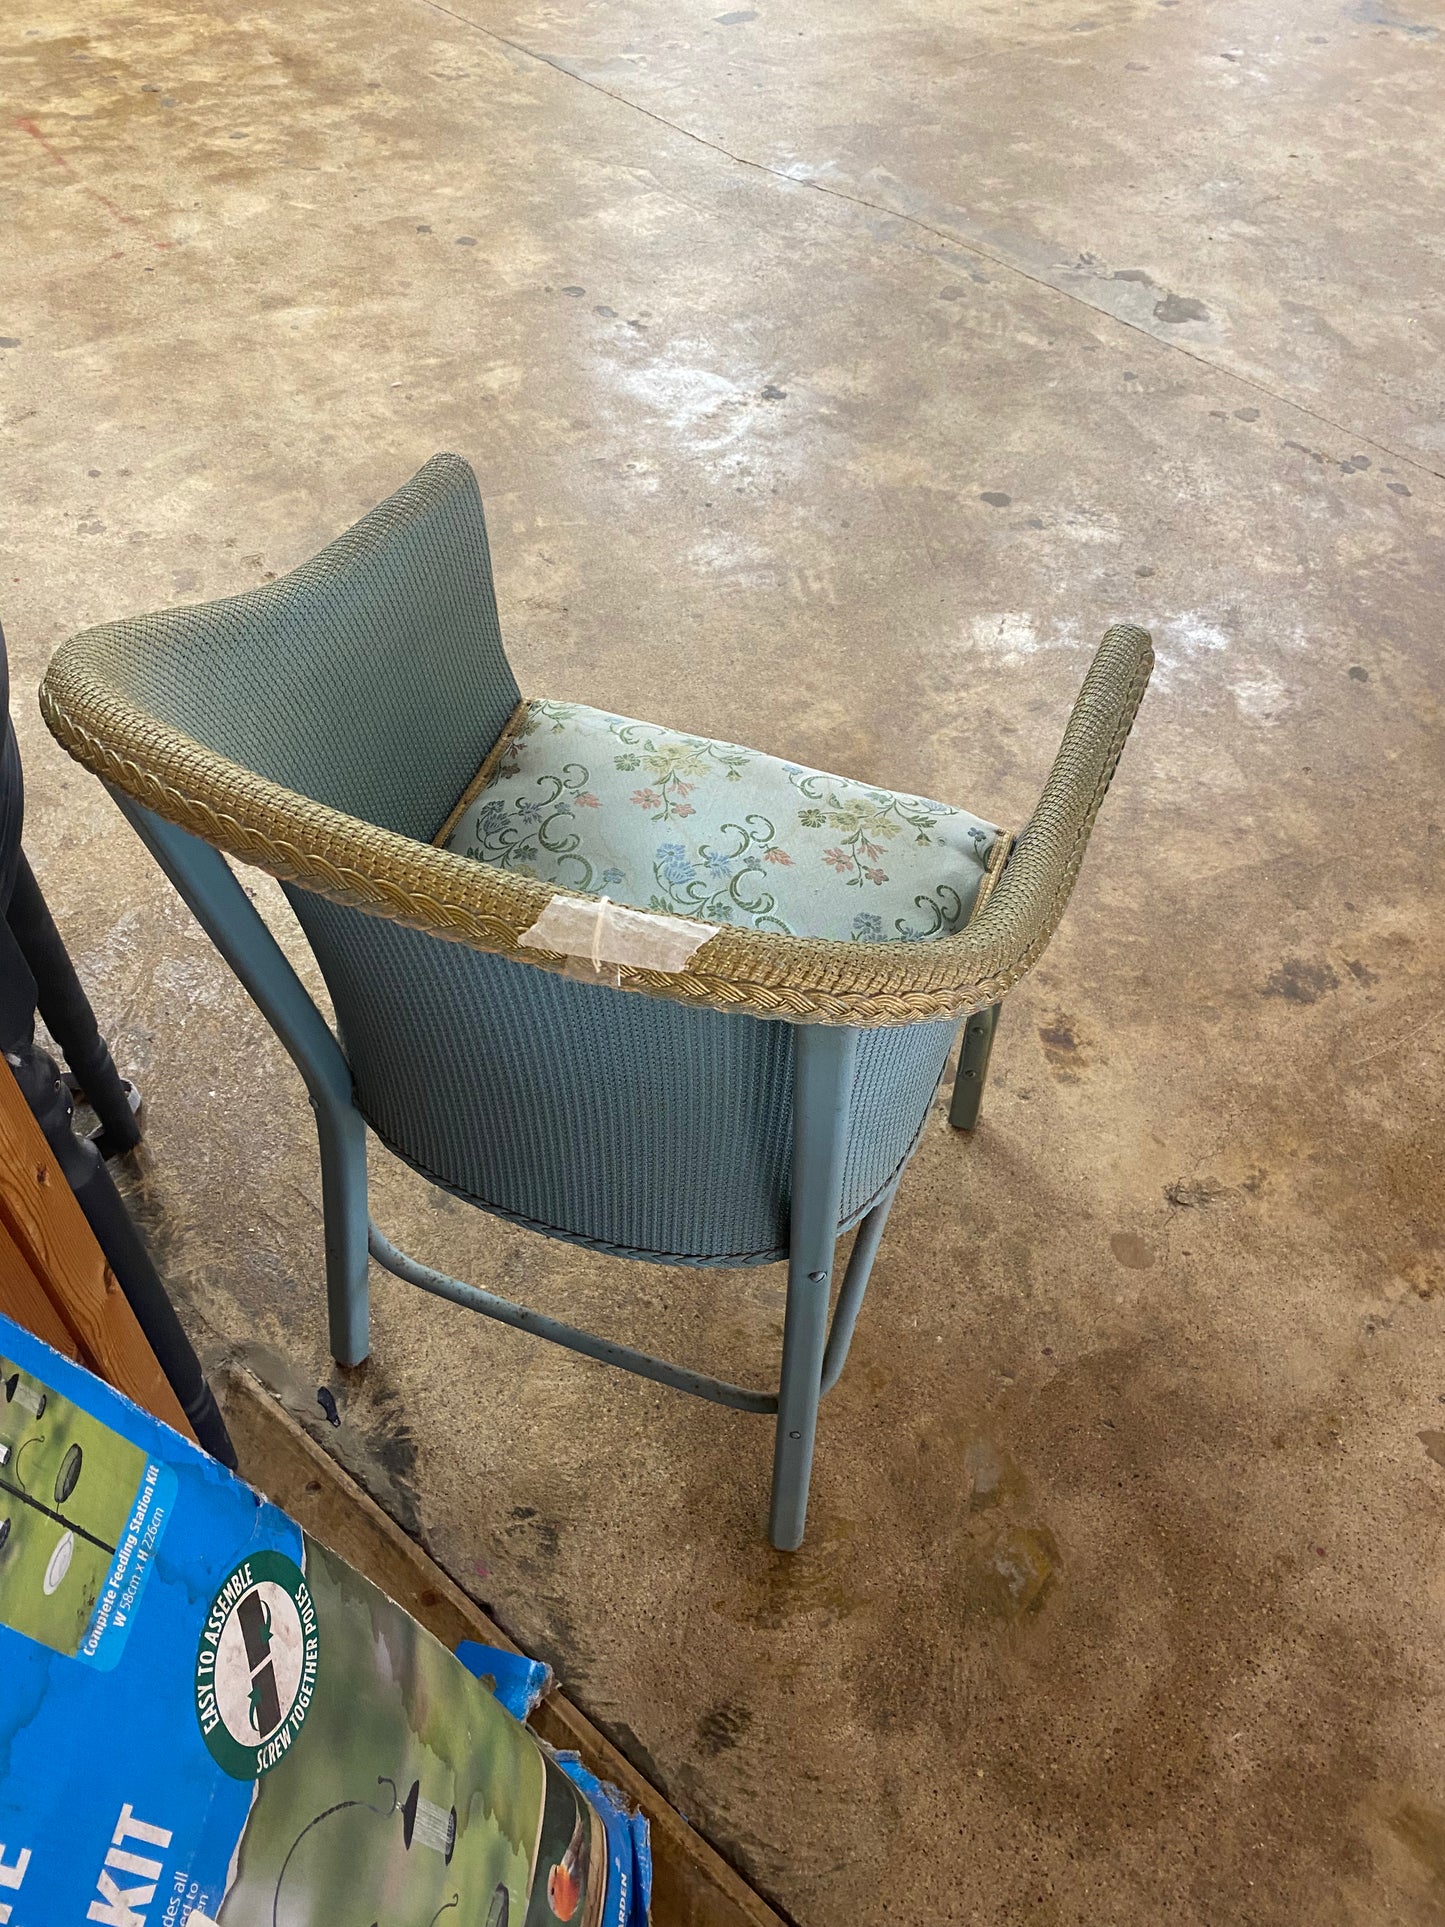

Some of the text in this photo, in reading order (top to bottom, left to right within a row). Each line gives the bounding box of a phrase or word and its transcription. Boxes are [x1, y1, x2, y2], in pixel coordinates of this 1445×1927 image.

[141, 1507, 165, 1550] 226cm
[83, 1464, 160, 1656] Complete Feeding Station Kit
[137, 1549, 149, 1563] H
[119, 1573, 142, 1611] 58cm
[112, 1611, 127, 1629] W
[198, 1562, 254, 1735] EASY TO ASSEMBLE
[256, 1582, 319, 1773] SCREW TOGETHER POLES
[86, 1803, 173, 1927] KIT
[174, 1871, 189, 1893] all
[185, 1883, 199, 1900] to
[617, 1872, 628, 1927] RDEN
